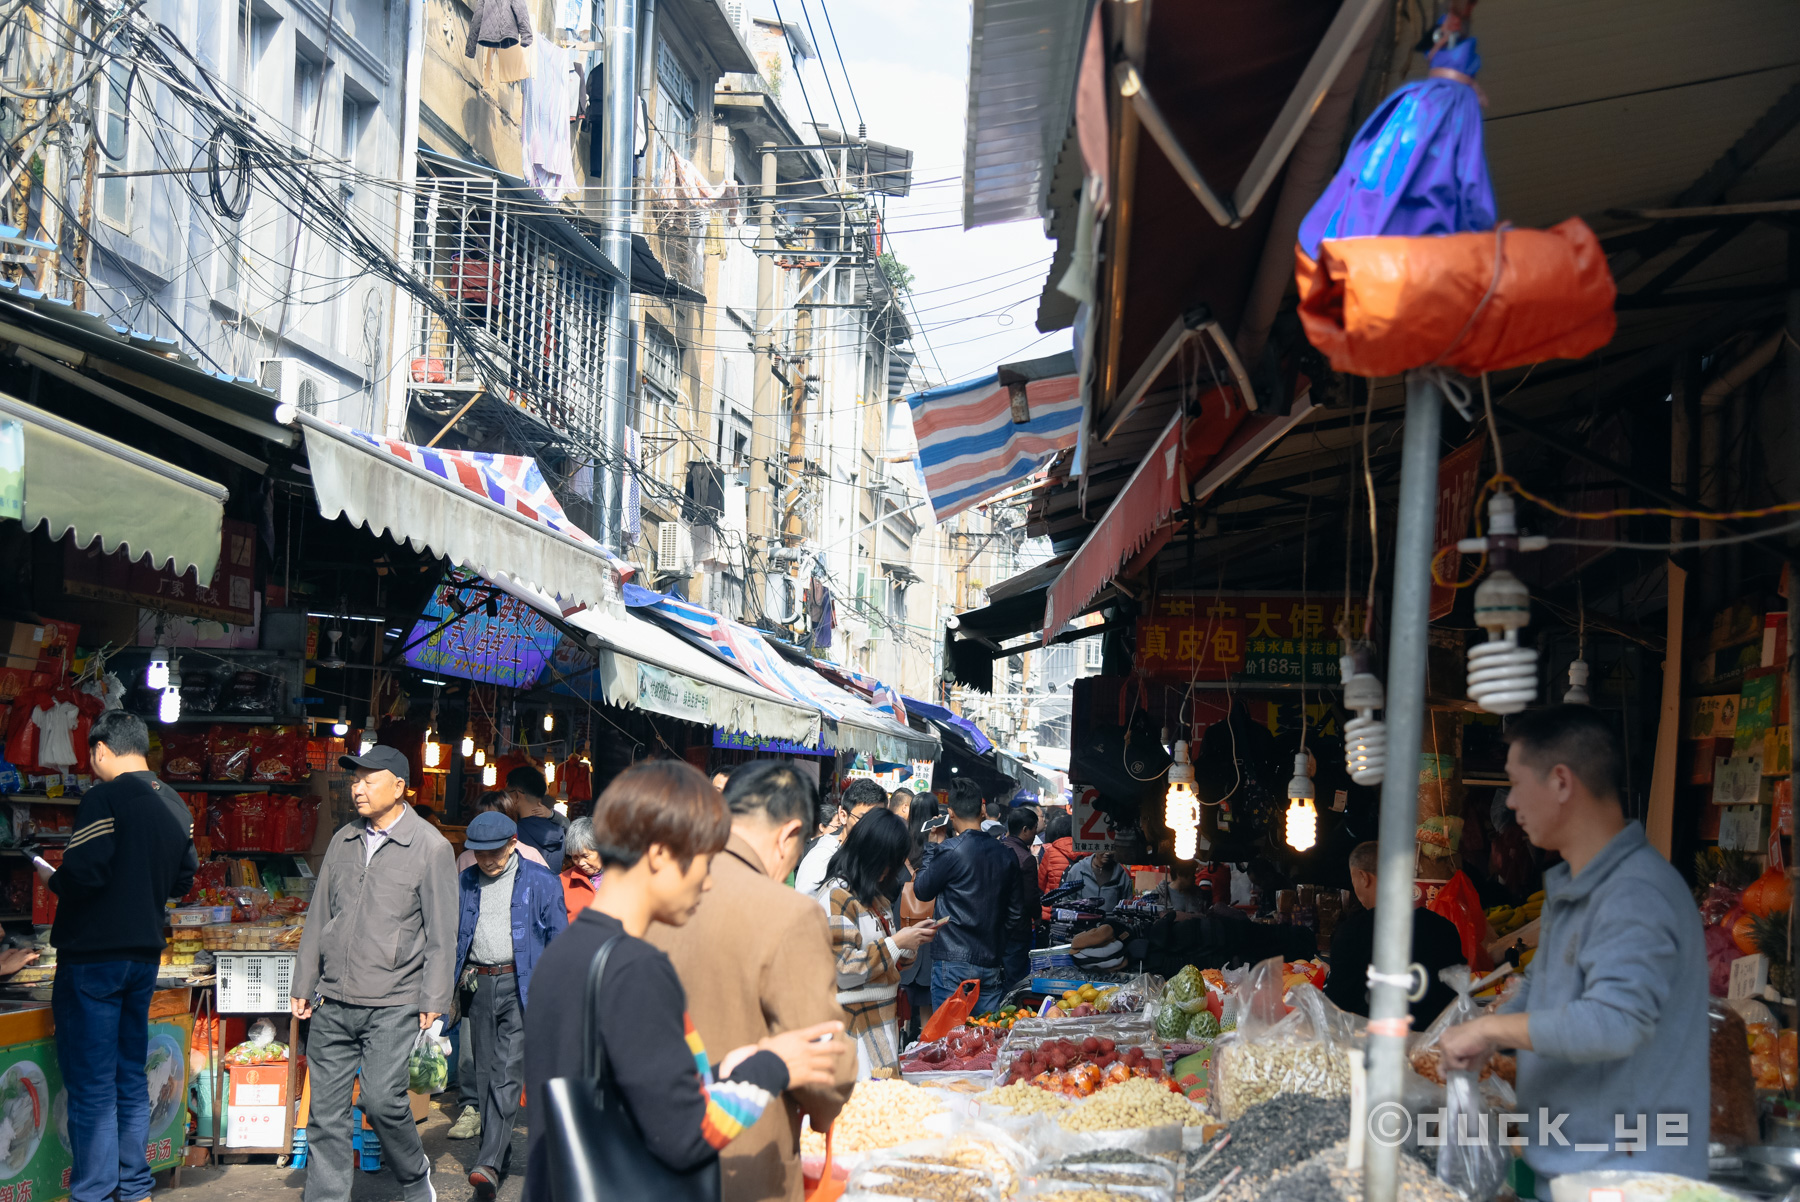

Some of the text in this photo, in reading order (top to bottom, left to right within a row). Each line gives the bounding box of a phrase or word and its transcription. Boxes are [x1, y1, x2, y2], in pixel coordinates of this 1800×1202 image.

[157, 577, 220, 606] 厂家 批发
[448, 618, 533, 664] 专业海鲜加工
[1141, 624, 1240, 662] 真皮包
